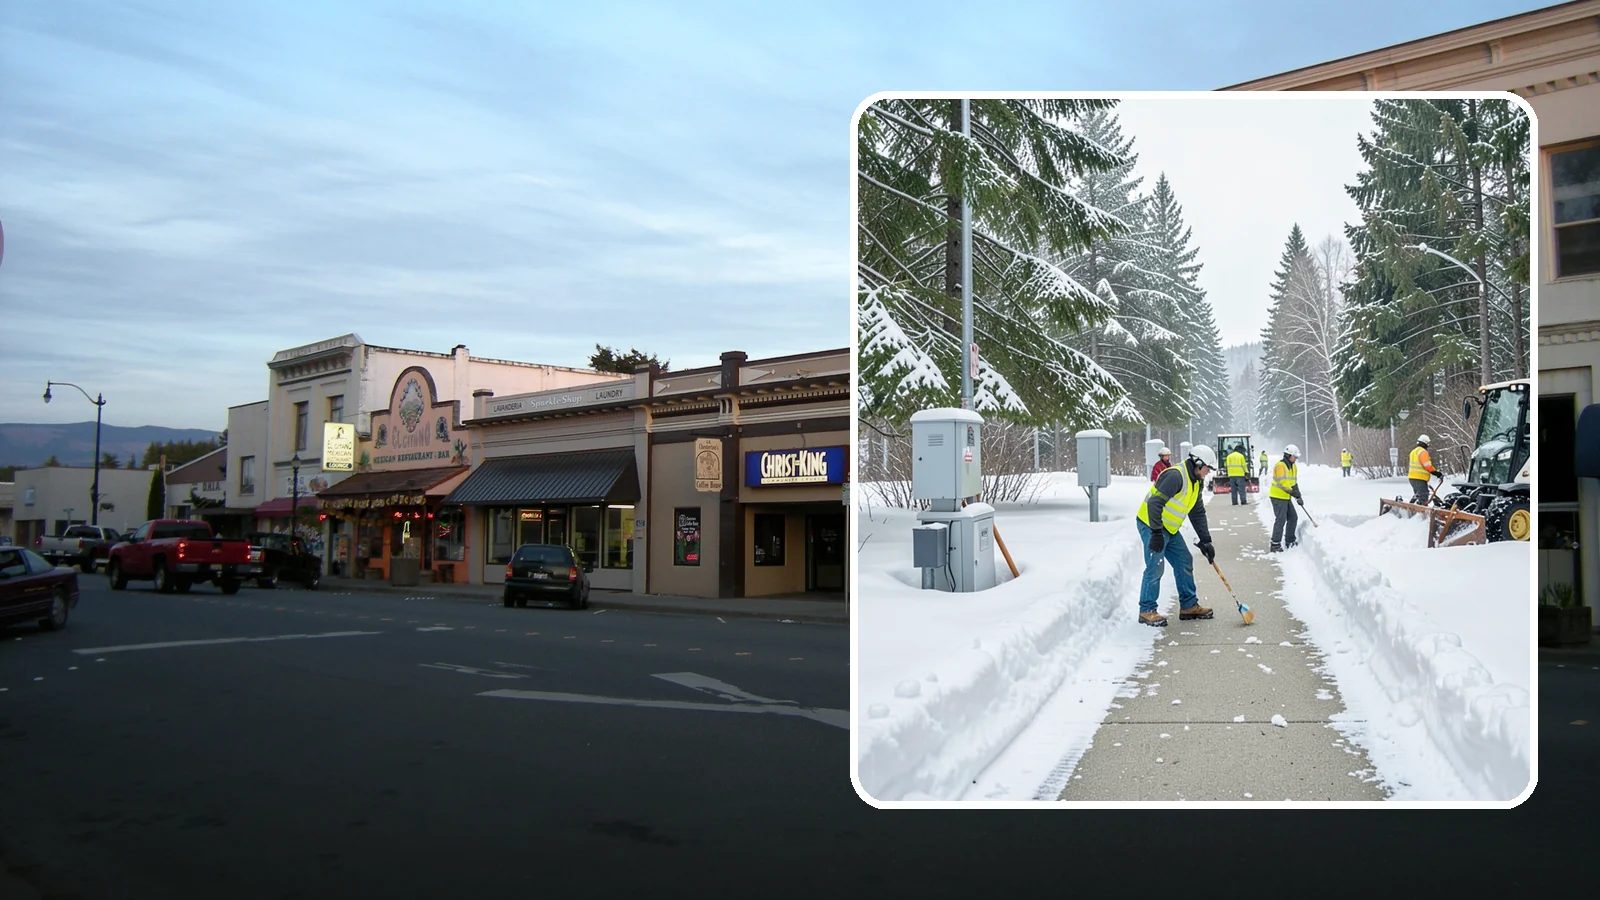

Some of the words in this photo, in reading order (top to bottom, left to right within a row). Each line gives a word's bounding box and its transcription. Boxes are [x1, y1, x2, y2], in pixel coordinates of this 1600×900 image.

[595, 389, 623, 400] LAUNDRY
[493, 402, 522, 413] LAVANDERIA
[531, 399, 560, 409] Sparkle
[562, 395, 583, 406] Shop
[373, 455, 396, 464] MEXICAN
[397, 452, 433, 462] RESTAURANT
[437, 450, 450, 459] BAR
[761, 452, 797, 478] CHRIST
[799, 450, 827, 476] KING
